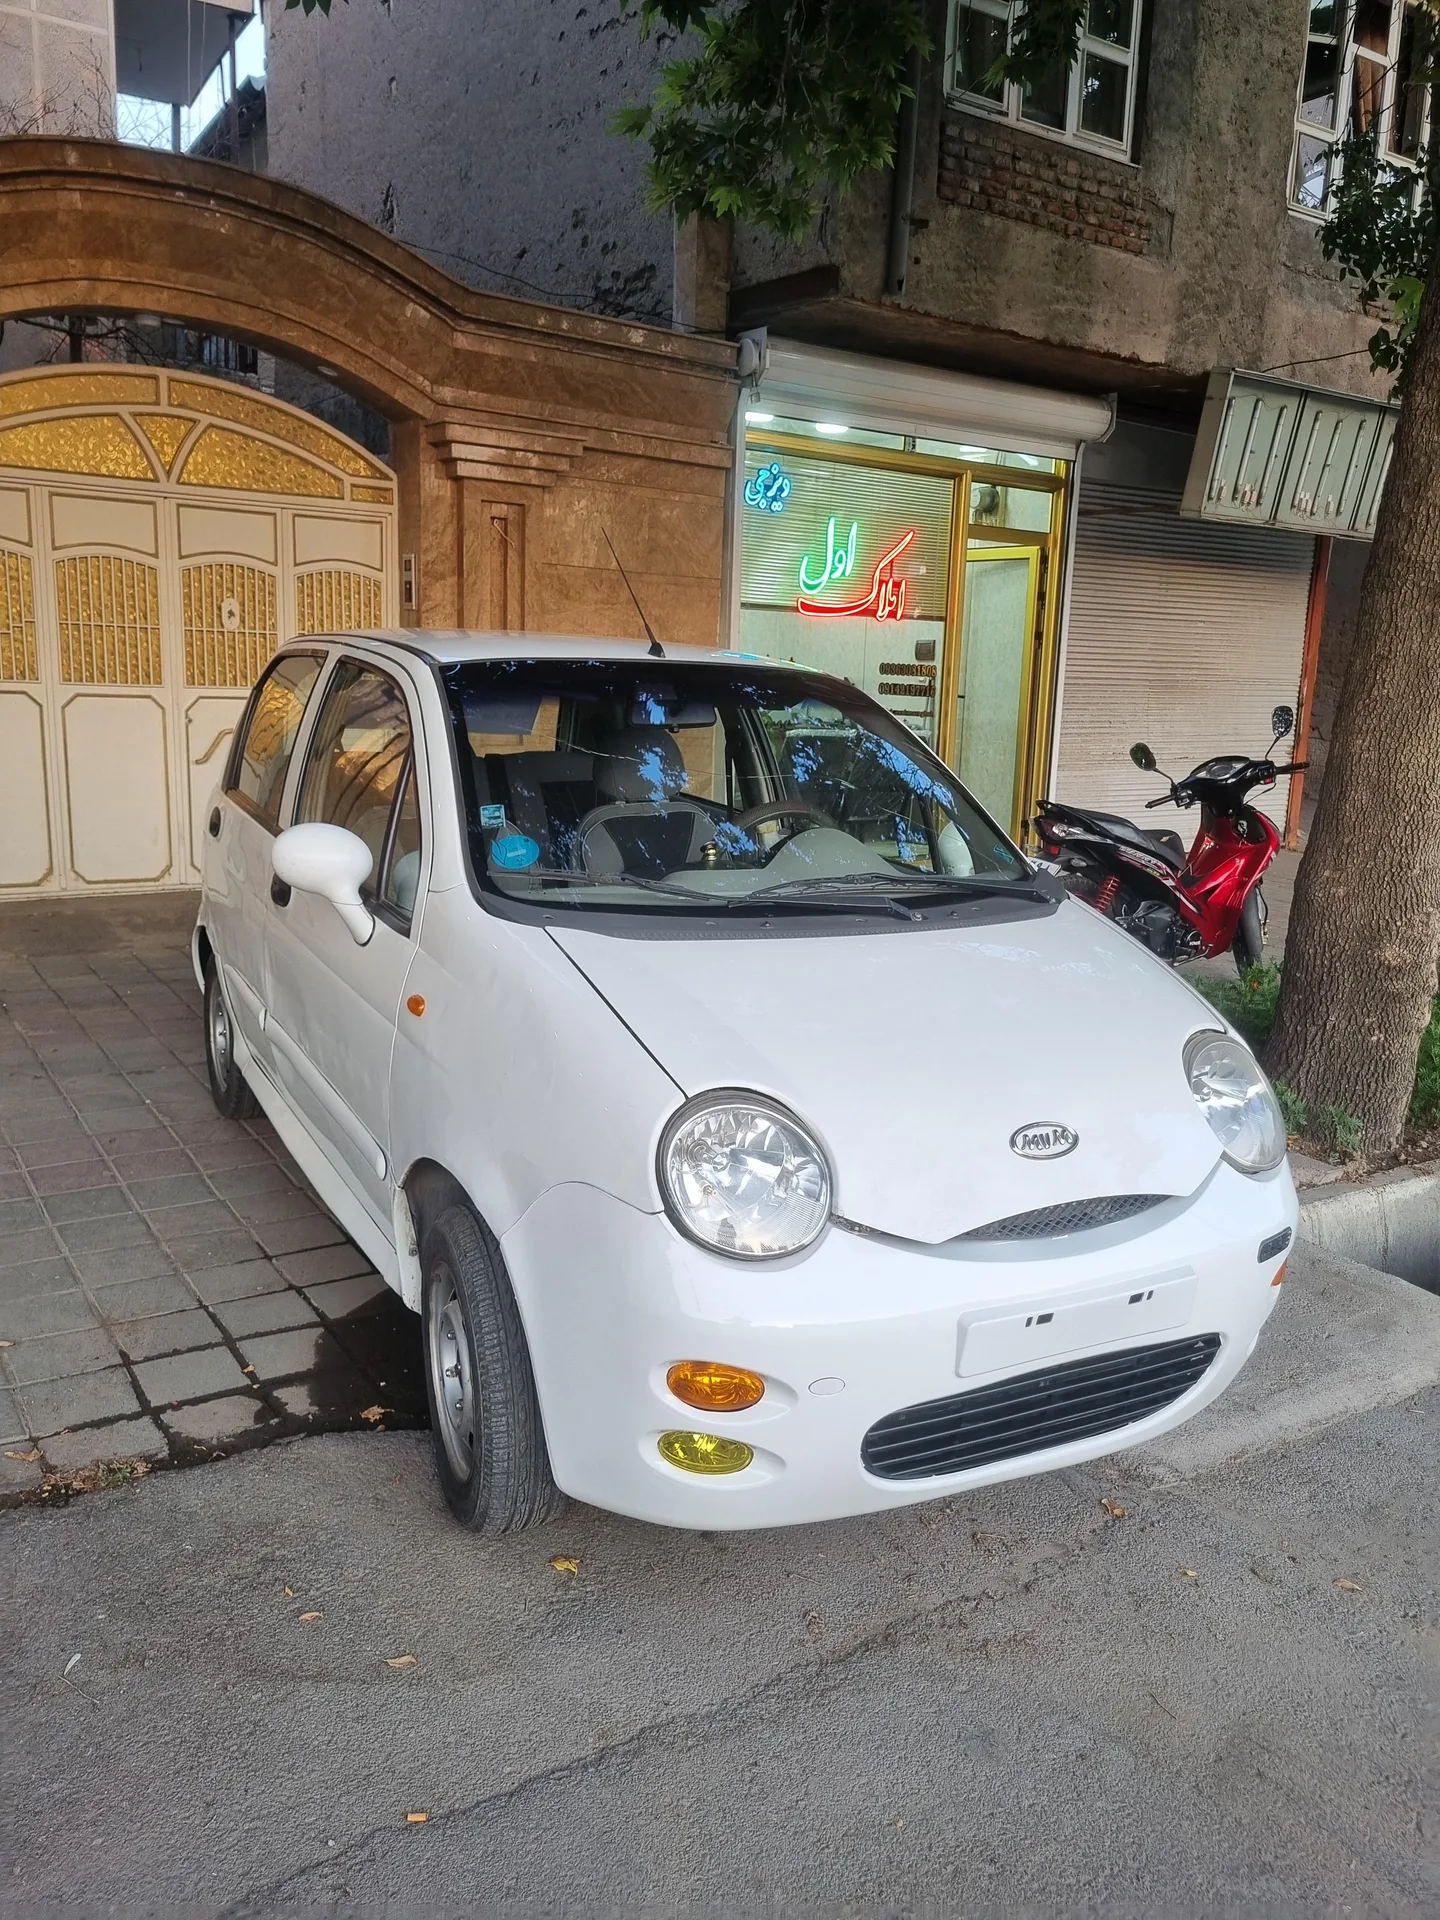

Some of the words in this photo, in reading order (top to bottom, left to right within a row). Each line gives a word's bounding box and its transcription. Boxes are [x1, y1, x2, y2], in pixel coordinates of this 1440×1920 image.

[797, 530, 915, 622] املاک
[798, 516, 858, 594] اول
[1021, 1129, 1073, 1151] MVM
